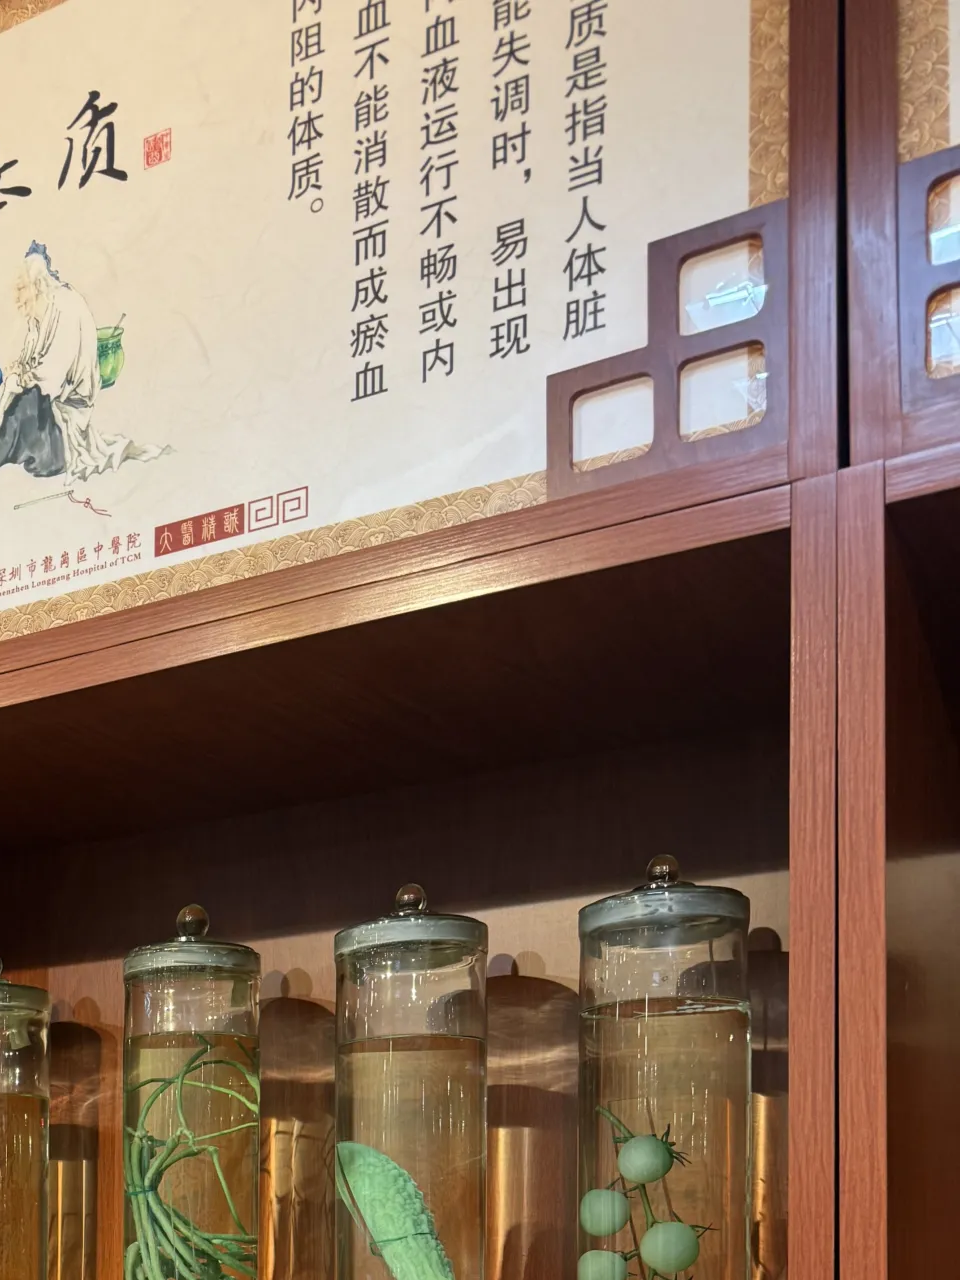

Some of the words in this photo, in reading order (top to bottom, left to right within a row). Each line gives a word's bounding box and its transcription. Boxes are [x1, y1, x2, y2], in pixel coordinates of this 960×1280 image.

[419, 0, 460, 384] 血液运行不畅或内
[31, 571, 72, 591] Longgang
[72, 563, 108, 582] Hospital
[109, 559, 120, 571] of
[120, 552, 142, 568] TCM
